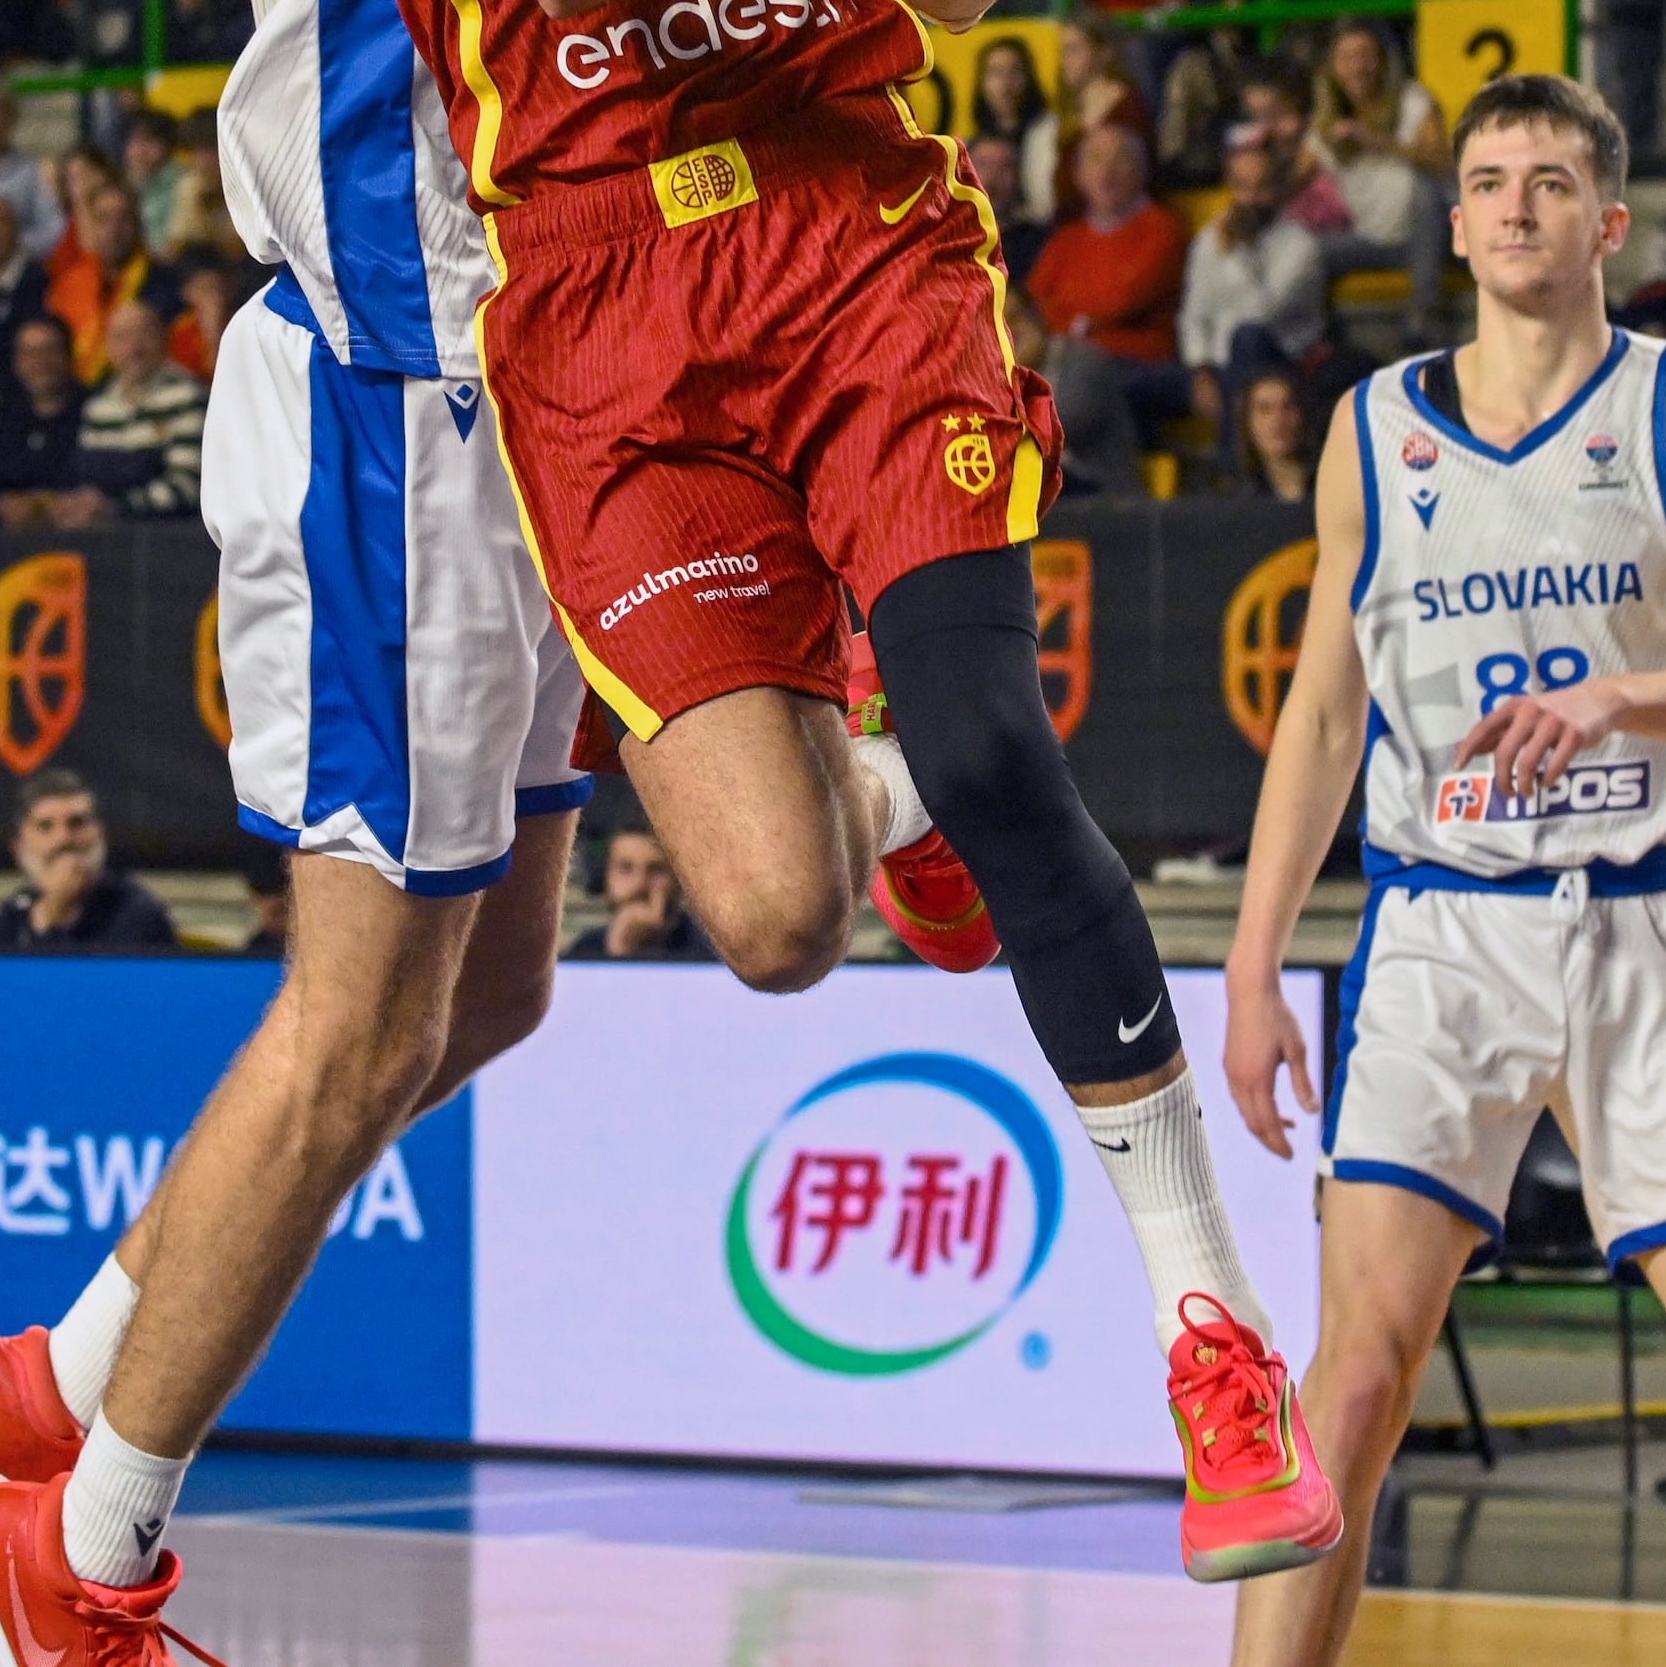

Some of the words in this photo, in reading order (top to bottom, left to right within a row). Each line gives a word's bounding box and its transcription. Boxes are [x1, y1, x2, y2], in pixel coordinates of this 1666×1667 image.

[599, 551, 759, 631] azulmarino
[693, 587, 729, 604] new
[730, 579, 771, 599] travel
[1413, 562, 1644, 622] SLOVAKIA
[773, 1150, 1007, 1281] 伊利
